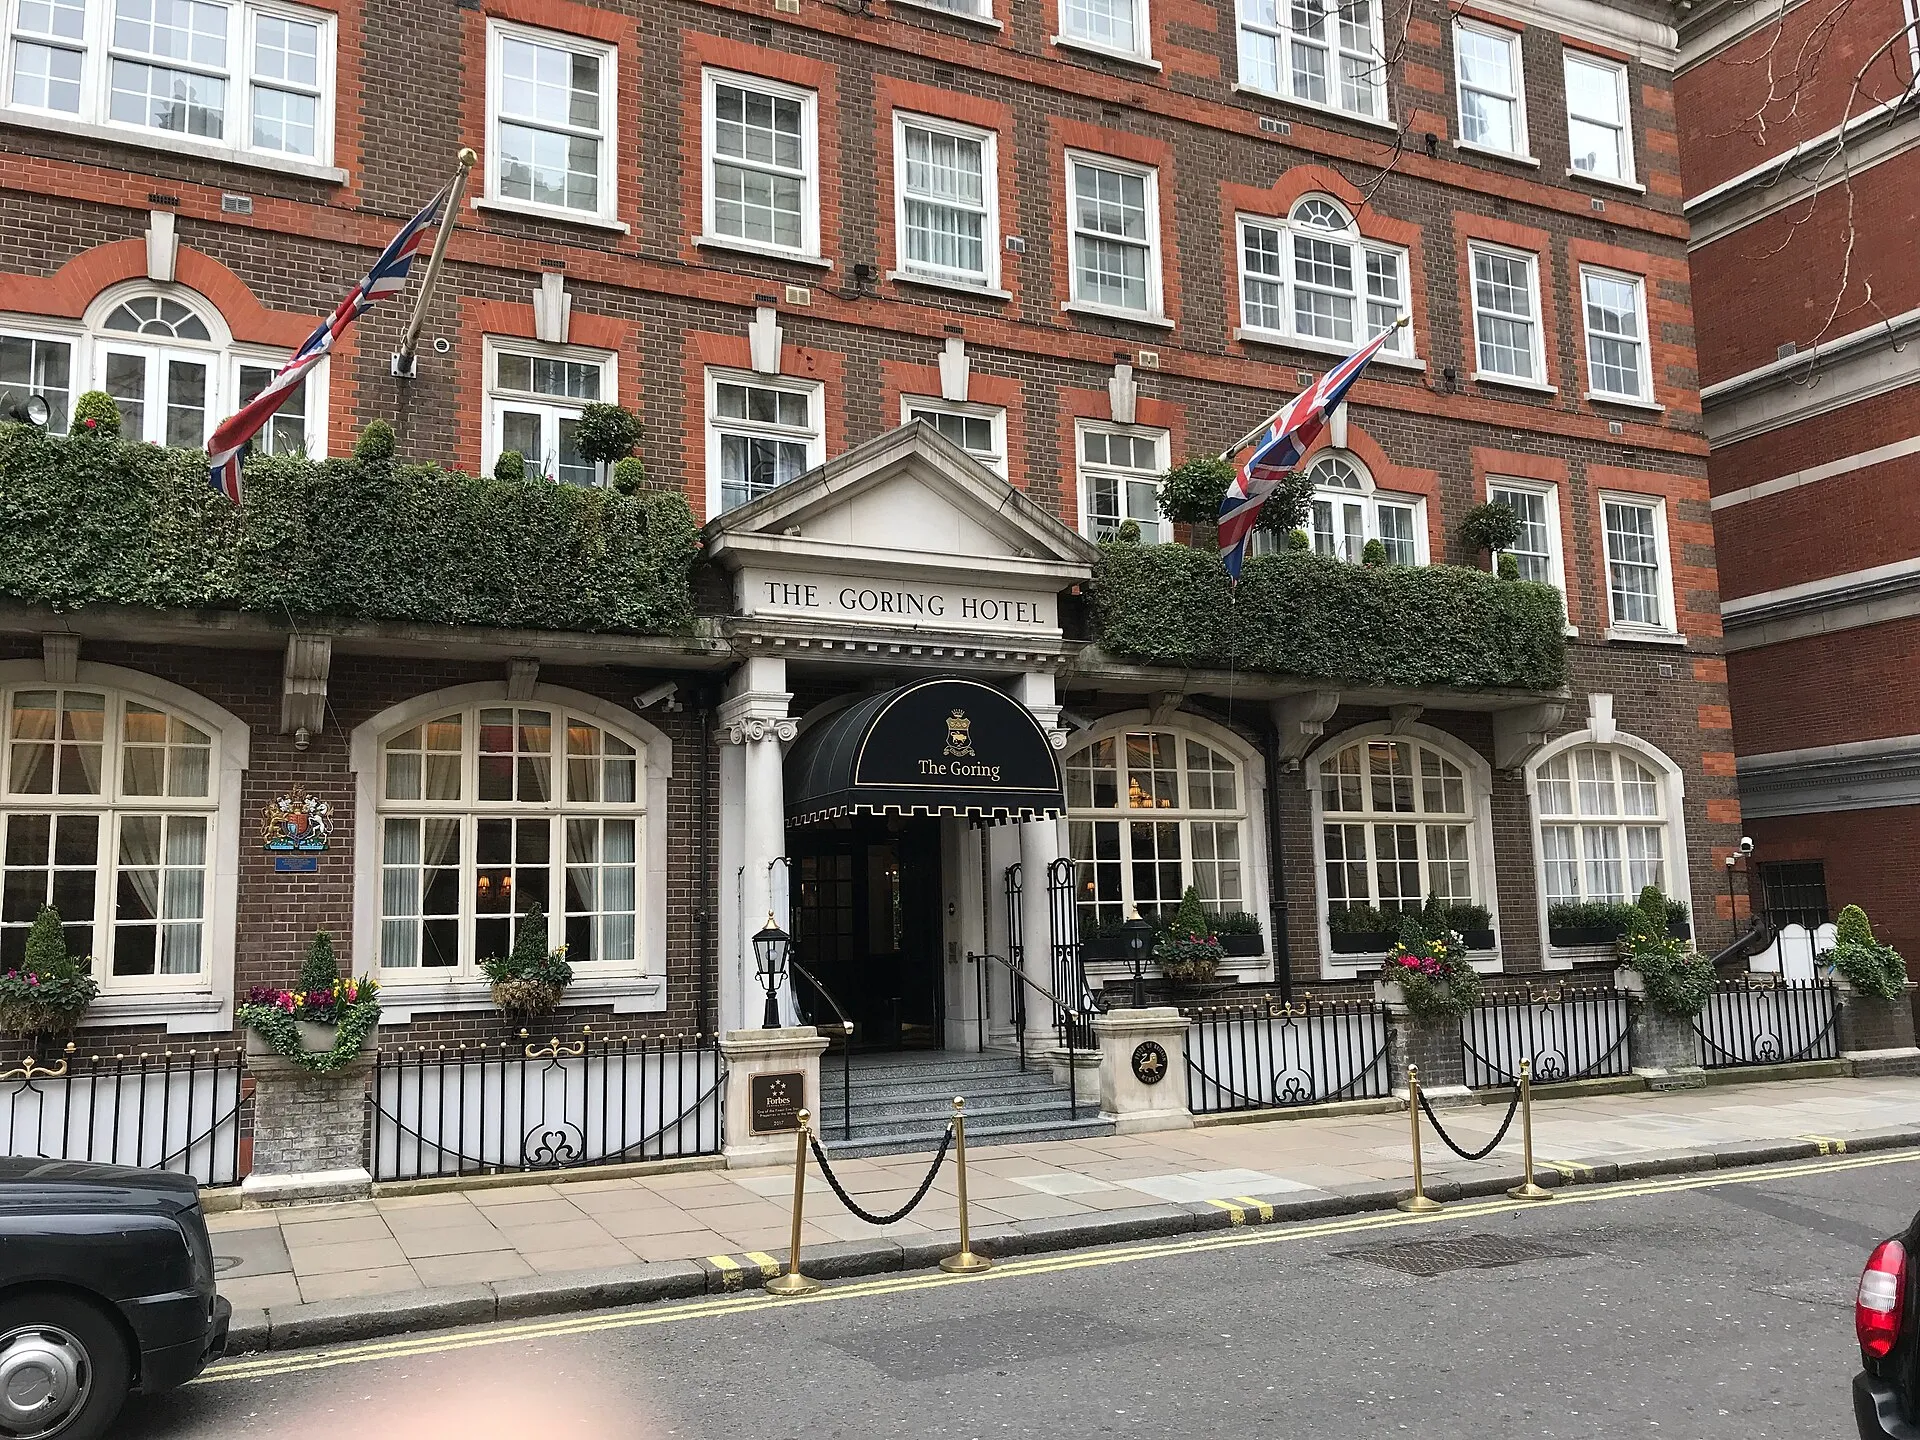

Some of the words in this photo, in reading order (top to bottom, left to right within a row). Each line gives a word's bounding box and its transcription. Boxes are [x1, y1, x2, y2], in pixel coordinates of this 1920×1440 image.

[764, 582, 820, 607] THE
[839, 588, 945, 616] GORING
[962, 597, 1045, 624] HOTEL
[918, 759, 947, 775] The
[950, 761, 1001, 782] Goring
[766, 1096, 791, 1105] Forbes
